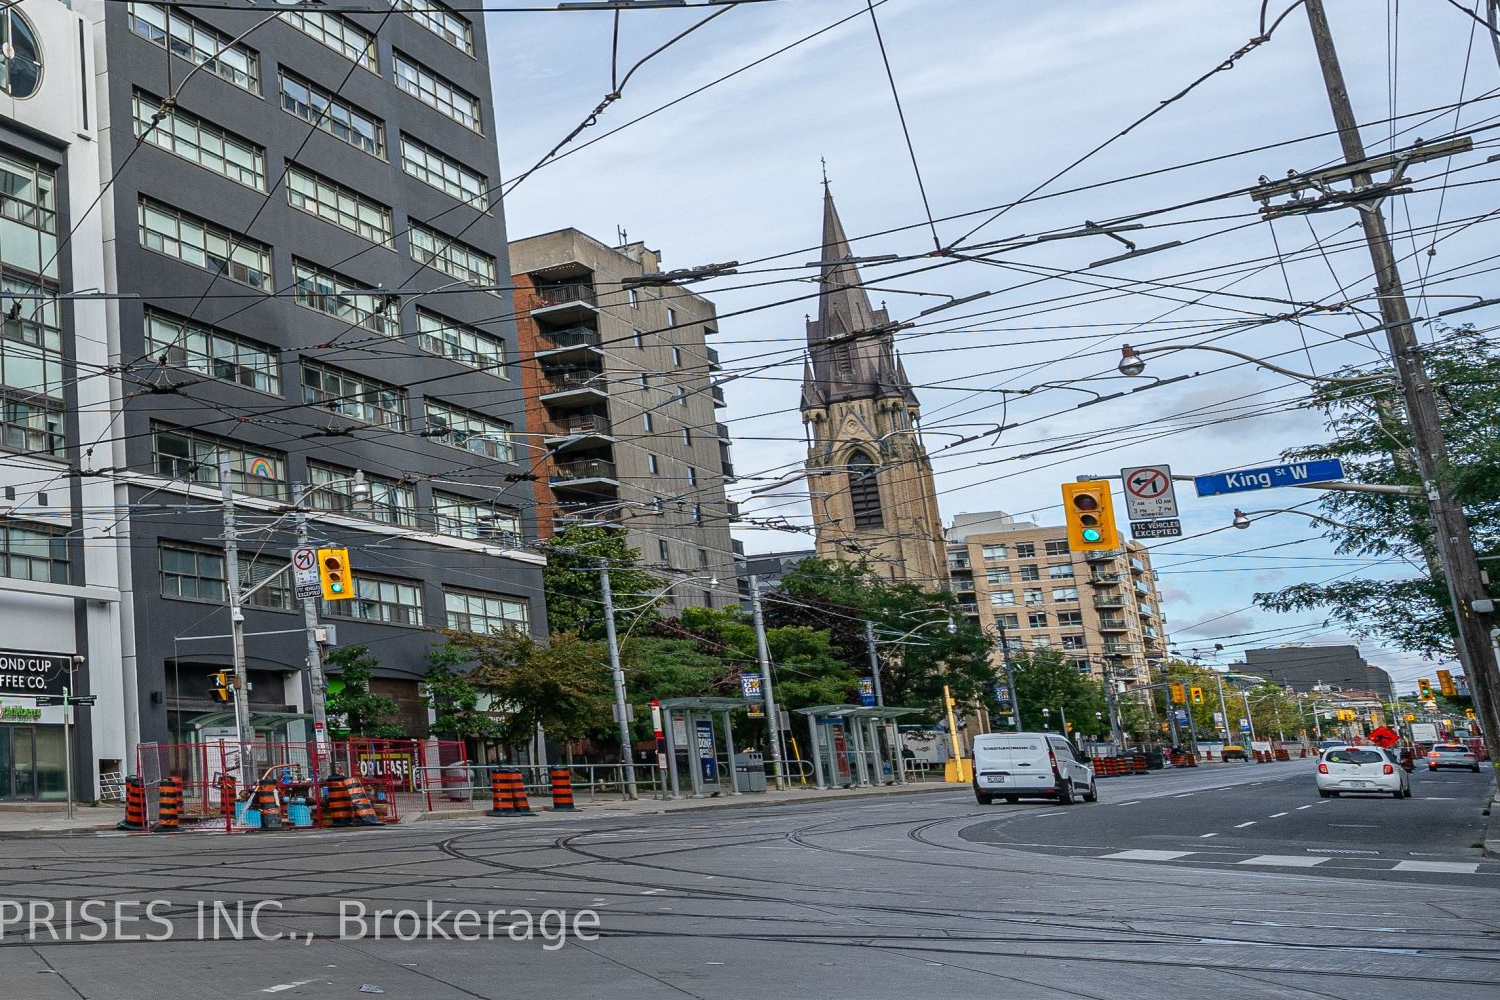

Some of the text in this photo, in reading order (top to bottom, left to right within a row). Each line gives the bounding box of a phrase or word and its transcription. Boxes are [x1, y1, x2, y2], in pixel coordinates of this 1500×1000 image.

[1225, 464, 1308, 488] King St W
[1147, 520, 1180, 529] VEHICLES
[1135, 528, 1179, 537] EXCEPTED
[28, 659, 52, 672] CUP
[27, 676, 47, 689] CO.
[358, 760, 409, 776] OR LEASE
